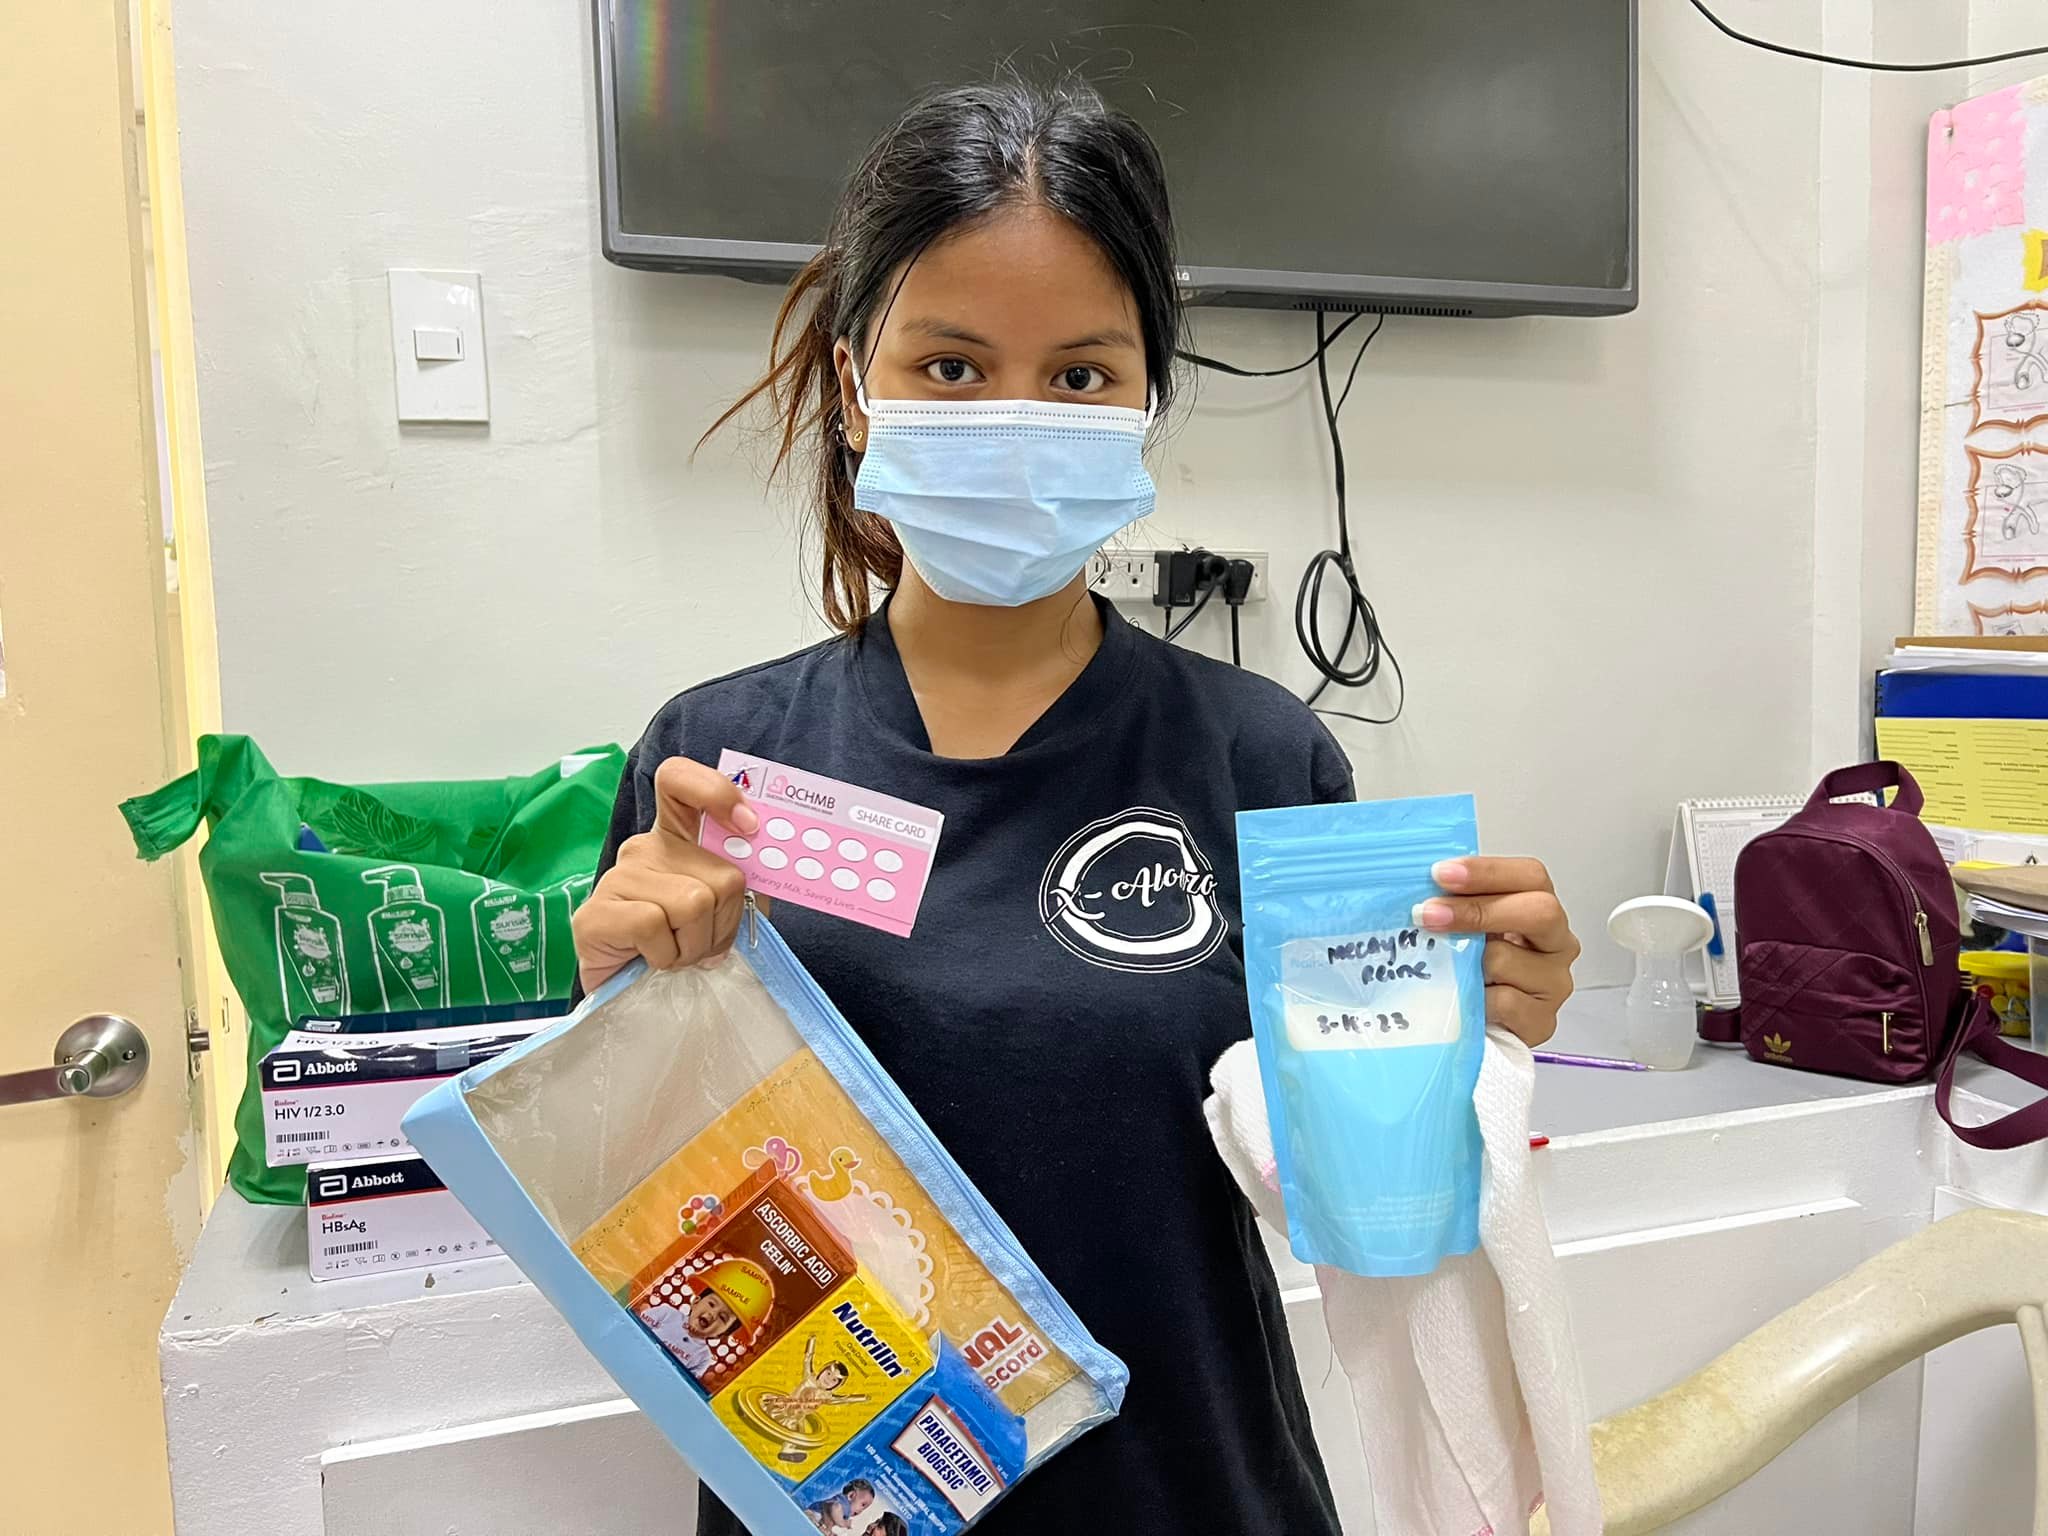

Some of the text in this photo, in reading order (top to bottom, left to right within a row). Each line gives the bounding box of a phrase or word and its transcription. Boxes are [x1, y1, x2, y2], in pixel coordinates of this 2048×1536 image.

[785, 784, 836, 809] QCHMB
[856, 809, 926, 839] SHARE CARD
[304, 1060, 358, 1076] Abbott
[275, 1103, 345, 1120] HIV 1/2 3.0
[351, 1171, 405, 1189] Abbott
[322, 1219, 367, 1234] HBsAg
[756, 1202, 810, 1260] ASCORBIC
[803, 1254, 834, 1285] ACID
[740, 1265, 769, 1288] SAMPLE
[720, 1284, 751, 1306] SAMPLE
[832, 1301, 903, 1378] Nutrilin
[919, 1415, 992, 1492] PARACETAMOL
[917, 1442, 964, 1490] BIOGESIC
